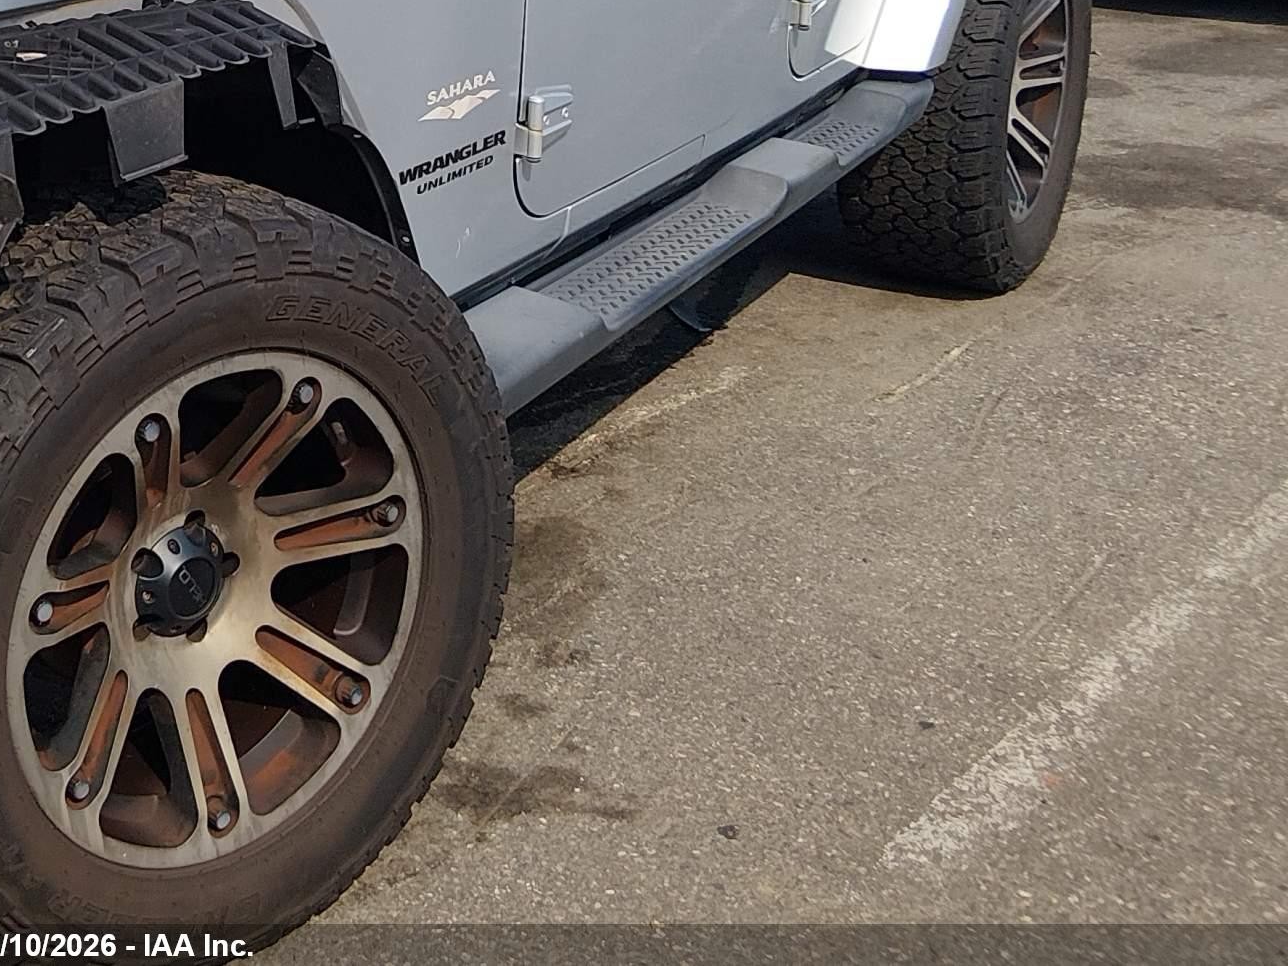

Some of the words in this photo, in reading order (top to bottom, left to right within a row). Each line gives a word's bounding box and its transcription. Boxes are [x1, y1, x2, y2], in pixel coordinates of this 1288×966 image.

[427, 70, 496, 105] SAHARA
[398, 129, 507, 185] WRANGLER
[416, 155, 494, 194] UNLIMITED
[265, 295, 444, 408] GENERAL
